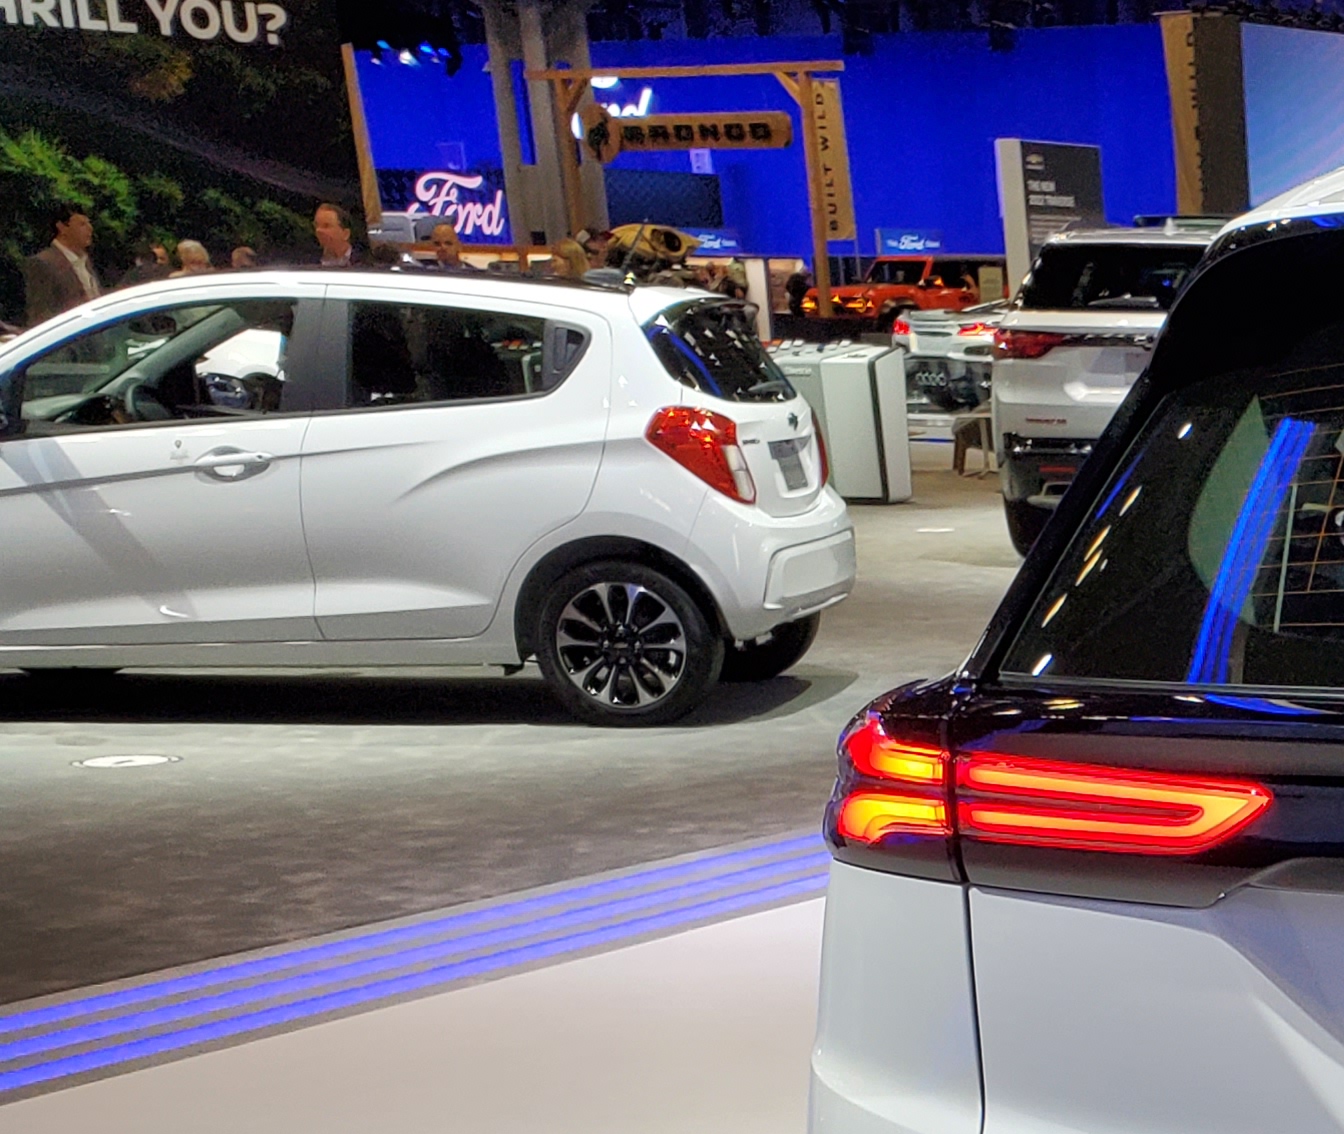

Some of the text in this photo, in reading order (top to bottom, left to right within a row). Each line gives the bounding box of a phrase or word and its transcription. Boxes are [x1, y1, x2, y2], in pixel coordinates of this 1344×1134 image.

[151, 0, 287, 45] YOU?
[623, 122, 773, 144] BRONCO
[815, 93, 838, 231] BUILT WILD
[406, 171, 504, 236] Ford
[899, 234, 925, 250] Ford
